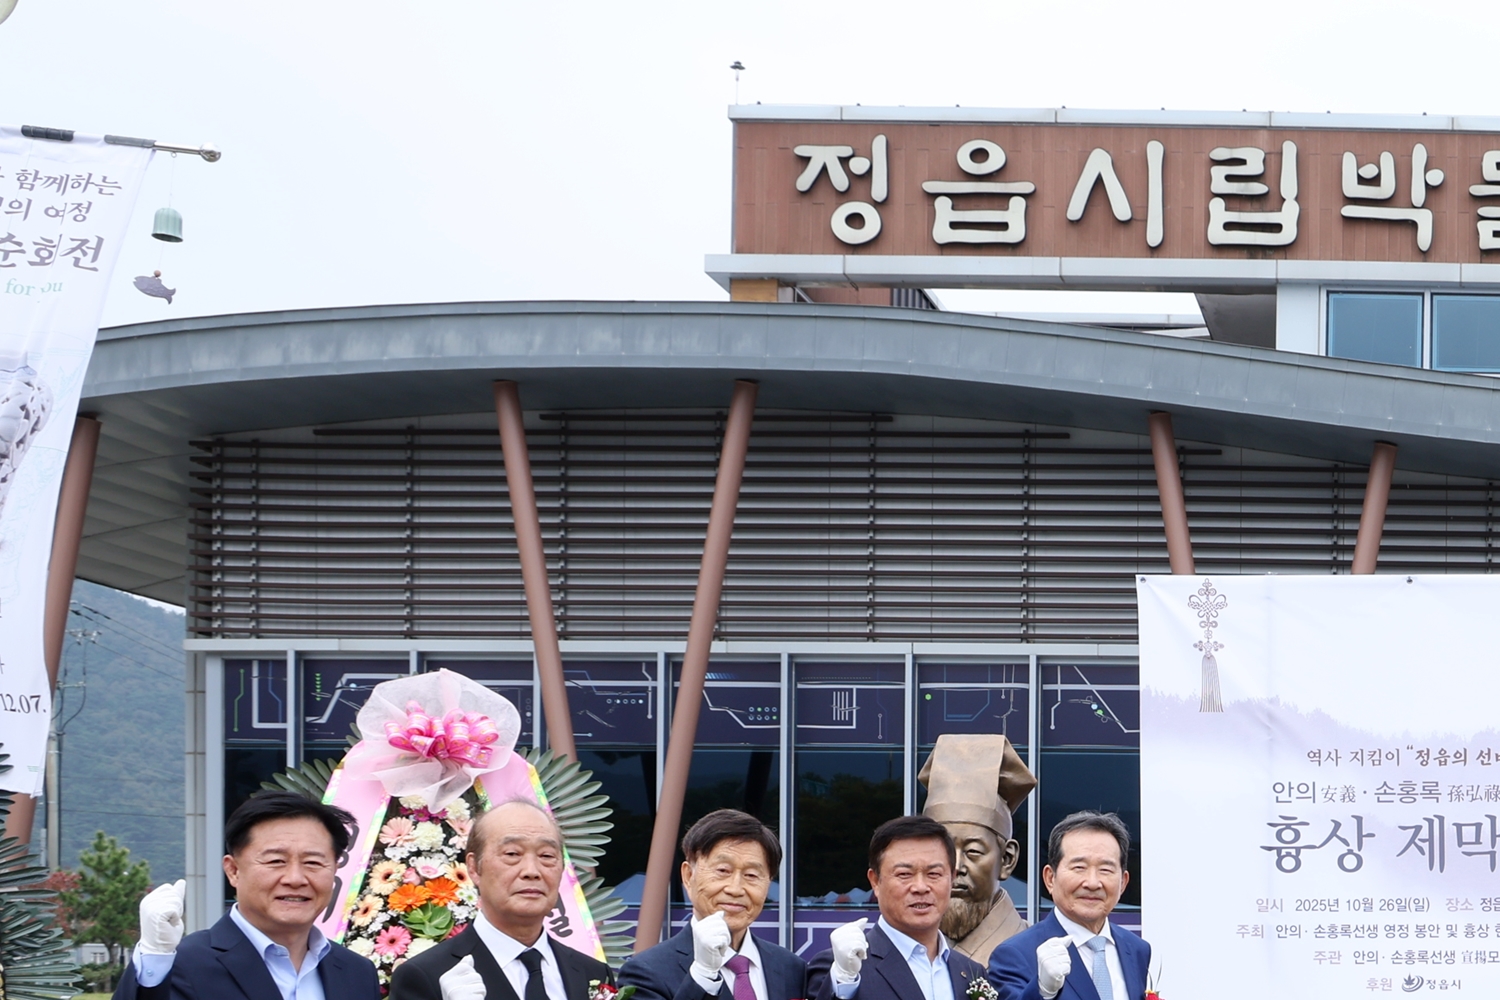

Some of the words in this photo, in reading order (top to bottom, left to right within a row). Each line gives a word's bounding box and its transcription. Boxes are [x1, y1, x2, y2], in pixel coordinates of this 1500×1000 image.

[15, 169, 122, 196] 함께하는
[44, 200, 93, 226] 여정
[4, 278, 35, 296] for
[1307, 748, 1342, 767] 역사
[1349, 748, 1400, 767] 지킴이
[1260, 814, 1375, 874] 흉상
[1256, 896, 1283, 912] 일시
[1295, 896, 1340, 912] 2025년
[1346, 896, 1374, 912] 10월
[1378, 896, 1431, 912] 26일(일)
[1446, 896, 1473, 912] 장소
[1236, 924, 1264, 939] 주최
[1313, 924, 1379, 939] 손홍록선생
[1384, 924, 1409, 939] 영정
[1414, 924, 1440, 939] 봉안
[1445, 924, 1458, 938] 및
[1463, 924, 1489, 938] 흉상
[1313, 950, 1342, 965] 주관
[1391, 950, 1456, 965] 손홍록선생
[1366, 978, 1392, 992] 후원
[1426, 979, 1462, 990] 정읍시
